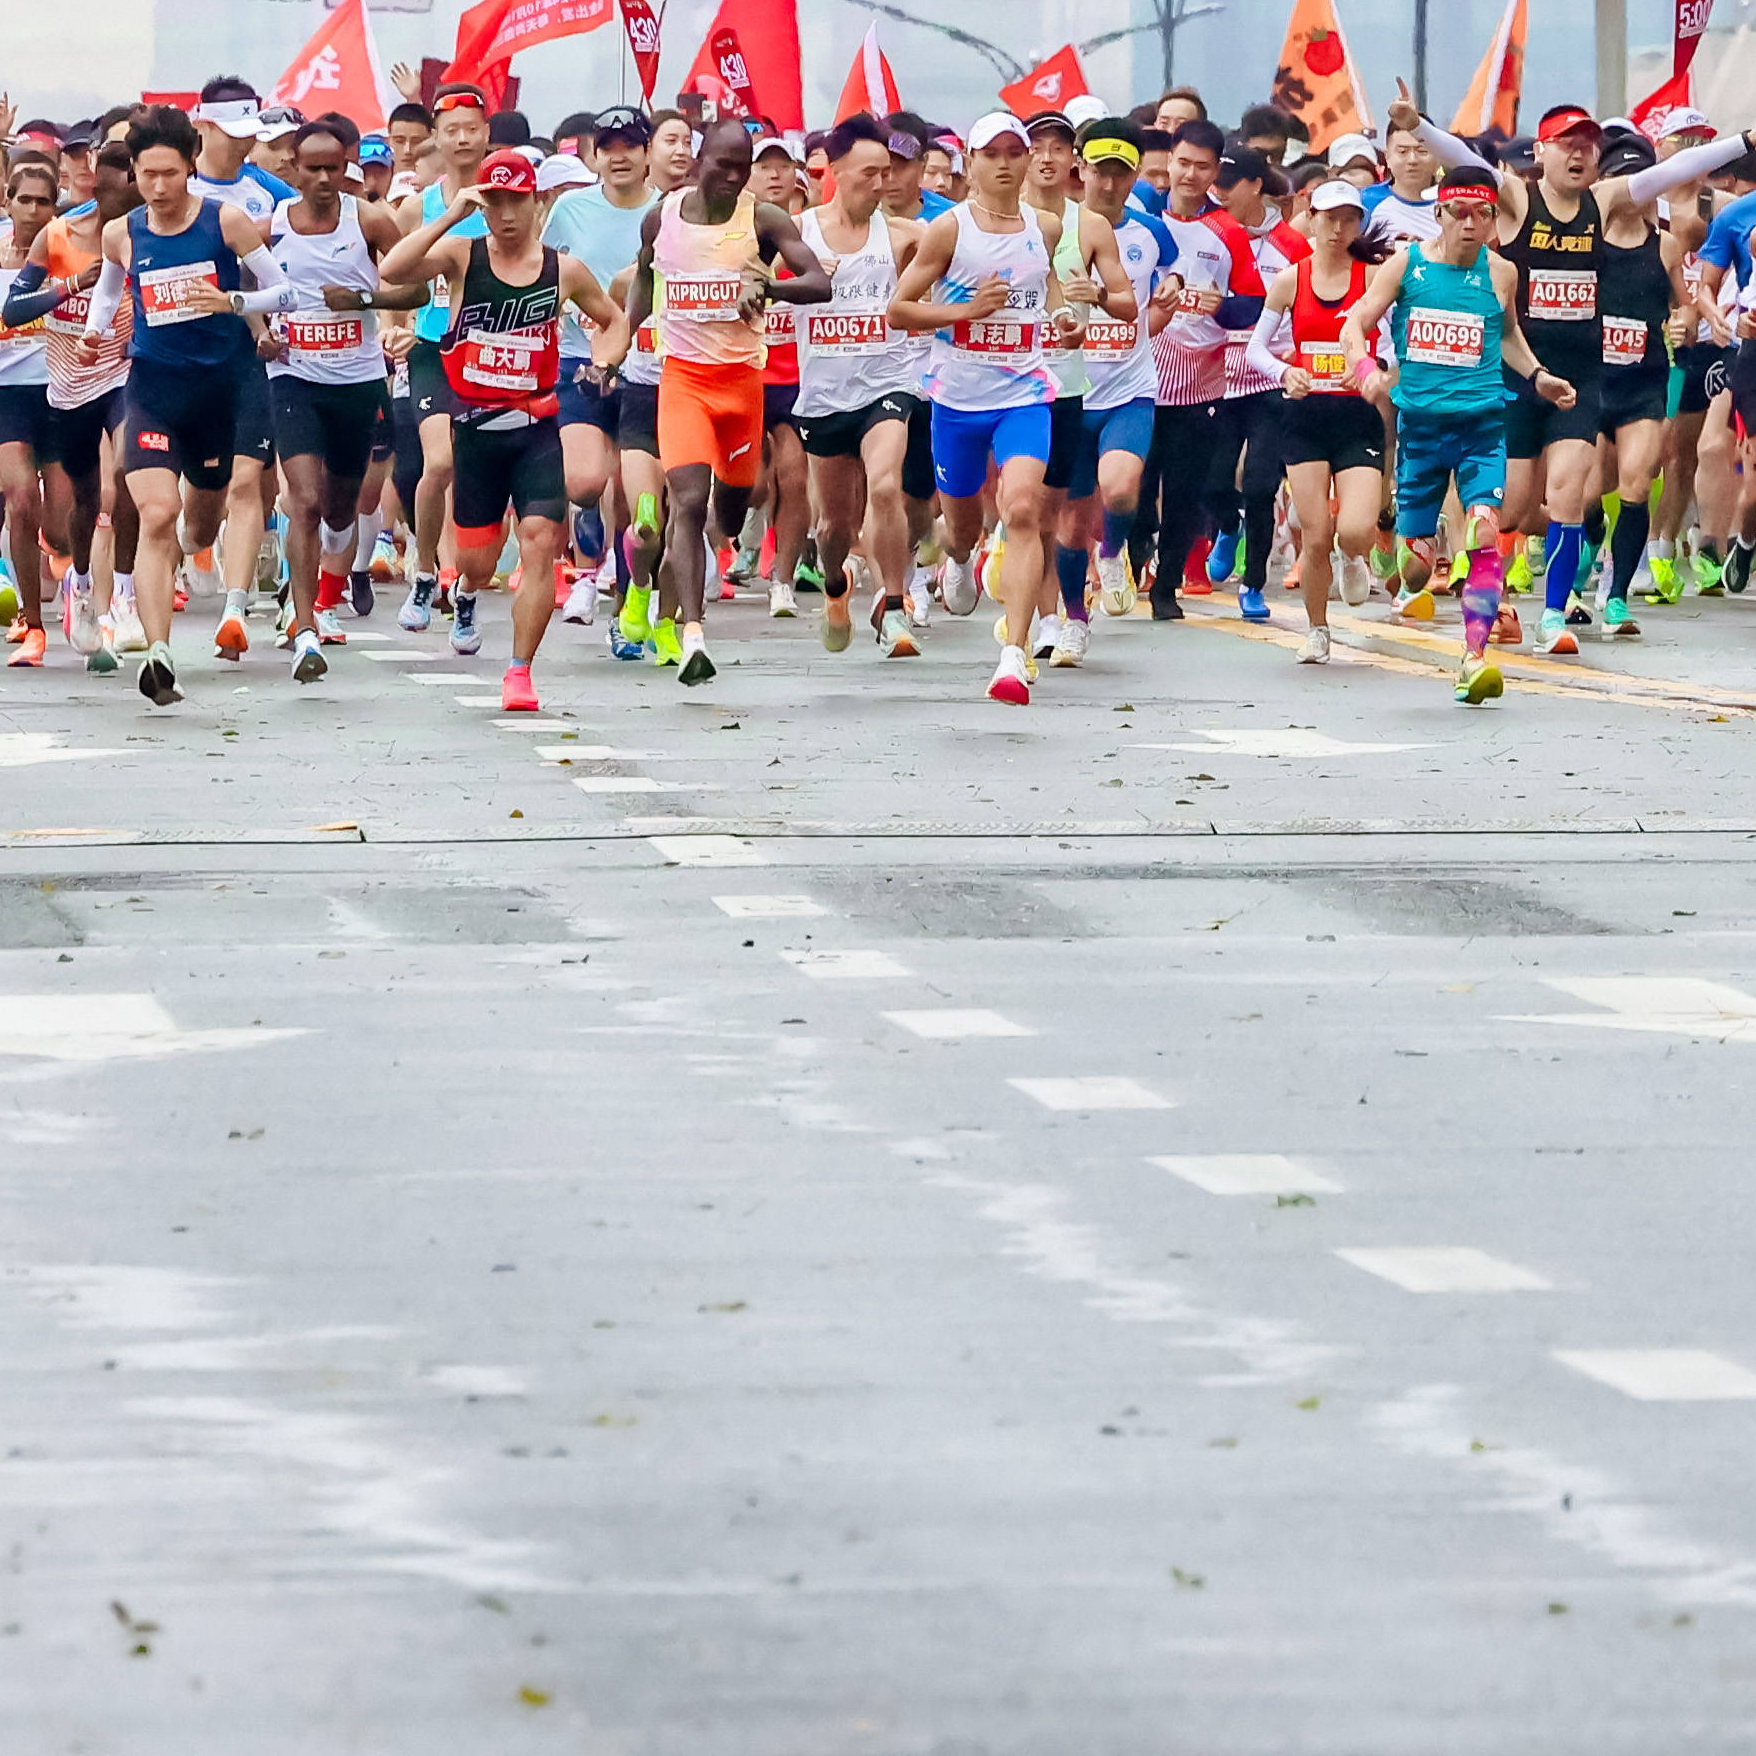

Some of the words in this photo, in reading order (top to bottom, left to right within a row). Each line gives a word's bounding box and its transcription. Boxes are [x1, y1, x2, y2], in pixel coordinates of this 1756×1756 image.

[667, 282, 740, 302] KIPRUGUT
[1532, 283, 1596, 302] A01662
[293, 322, 357, 343] TEREFE
[811, 316, 884, 339] A00671
[968, 323, 1022, 346] 黄志鹏
[1410, 321, 1481, 348] A00699
